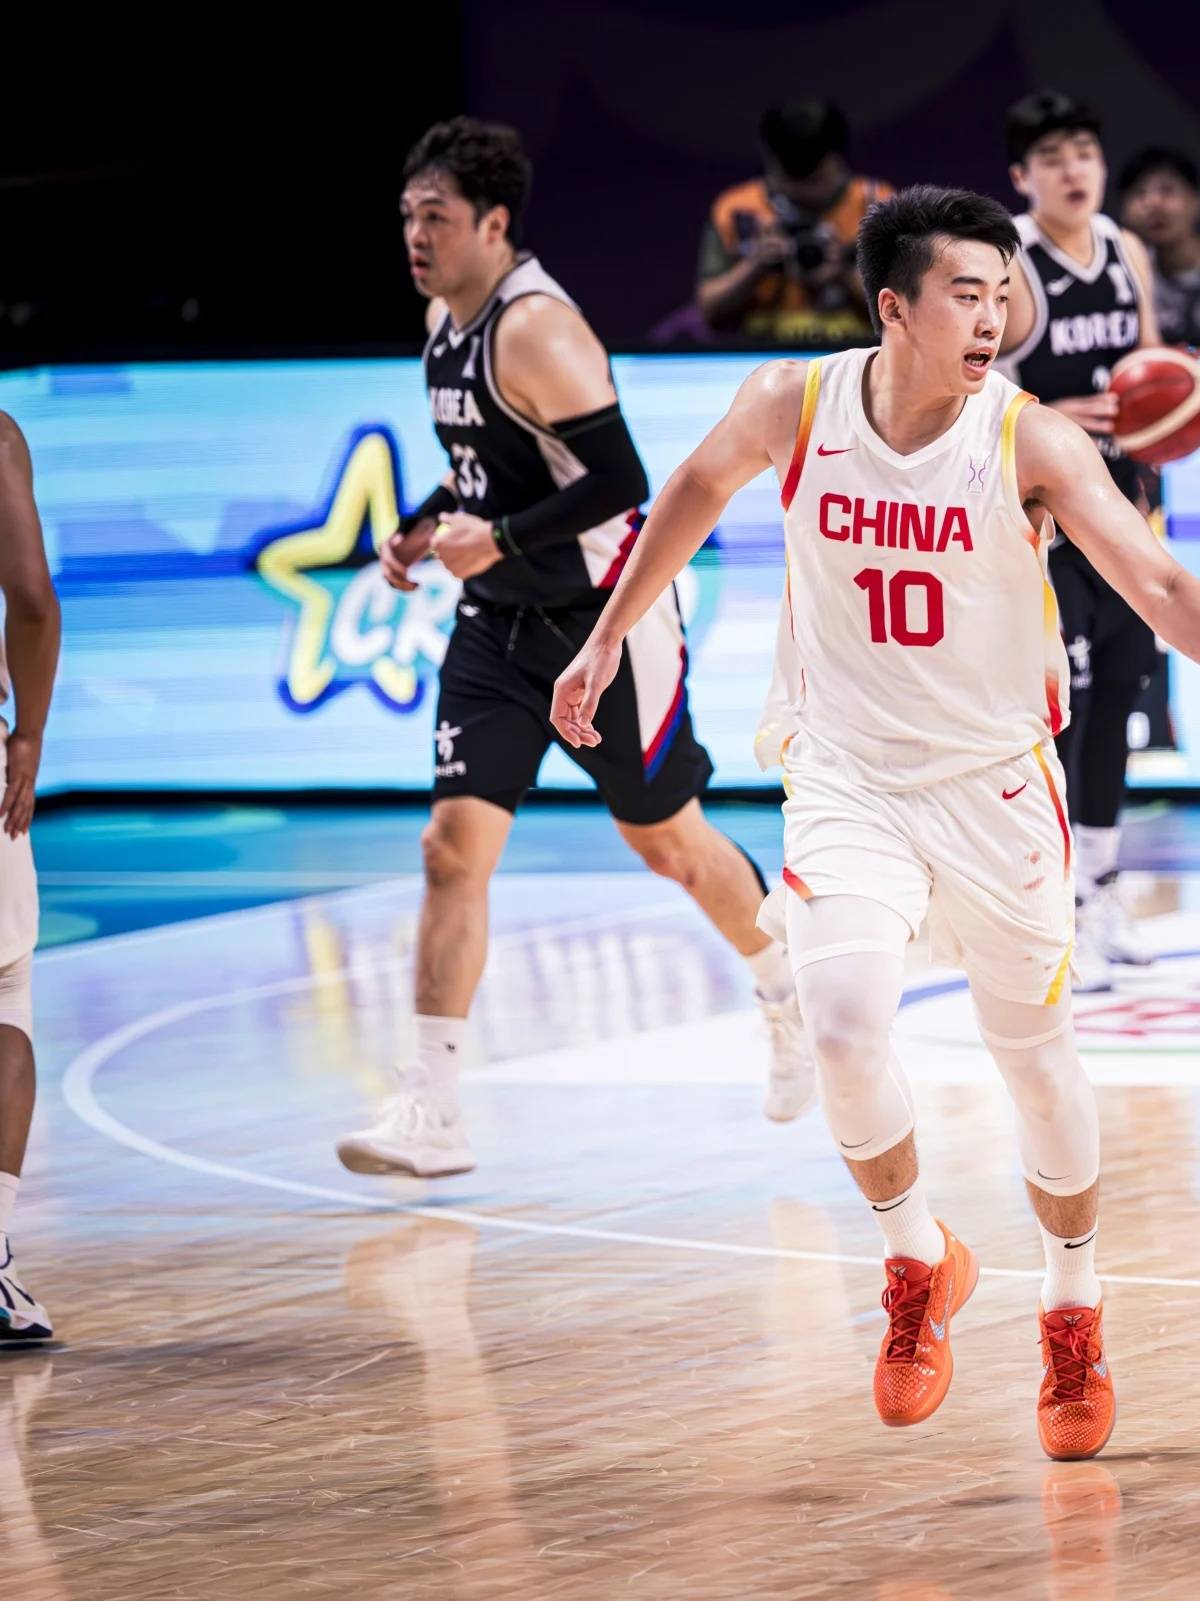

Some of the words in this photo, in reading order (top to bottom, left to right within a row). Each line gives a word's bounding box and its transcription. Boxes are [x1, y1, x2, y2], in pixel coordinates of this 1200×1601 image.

[1050, 311, 1138, 356] KOREA
[819, 492, 974, 553] CHINA
[853, 568, 945, 647] 10
